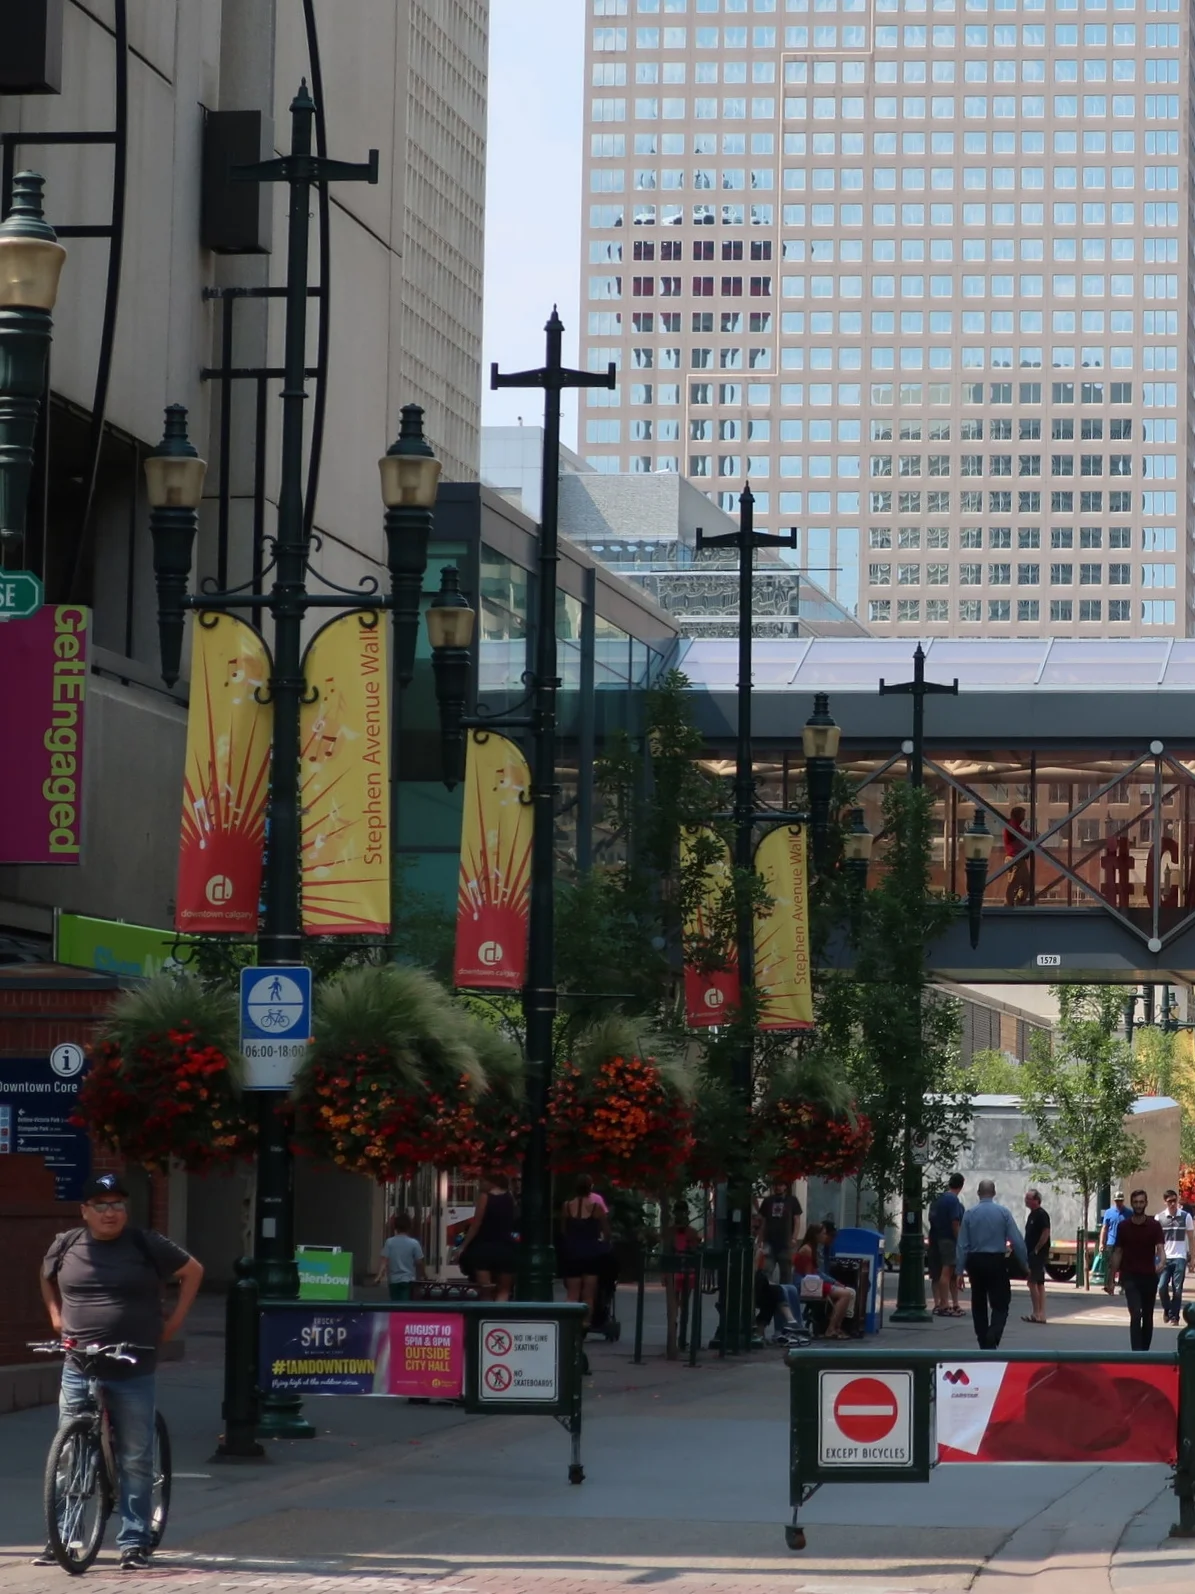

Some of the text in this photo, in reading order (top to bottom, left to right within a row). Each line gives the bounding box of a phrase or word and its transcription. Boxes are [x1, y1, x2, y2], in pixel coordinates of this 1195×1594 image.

[42, 604, 88, 853] GetEngaged
[359, 620, 387, 865] Stephen Avenue Walk
[791, 868, 804, 922] Avenue
[181, 909, 253, 920] downtown calgary
[793, 925, 808, 985] Stephen
[1040, 956, 1057, 964] 1578
[245, 1045, 305, 1058] 06:00-18:00
[54, 1081, 78, 1093] Core
[404, 1325, 441, 1336] AUGUST
[404, 1337, 422, 1346] 5PM
[424, 1337, 431, 1346] &
[513, 1334, 522, 1342] NO
[405, 1347, 450, 1360] OUTSIDE
[272, 1359, 375, 1376] #IAMDOWNTOWN
[405, 1361, 450, 1372] CITY HALL
[826, 1448, 905, 1460] EXCEPT BICYCLES
